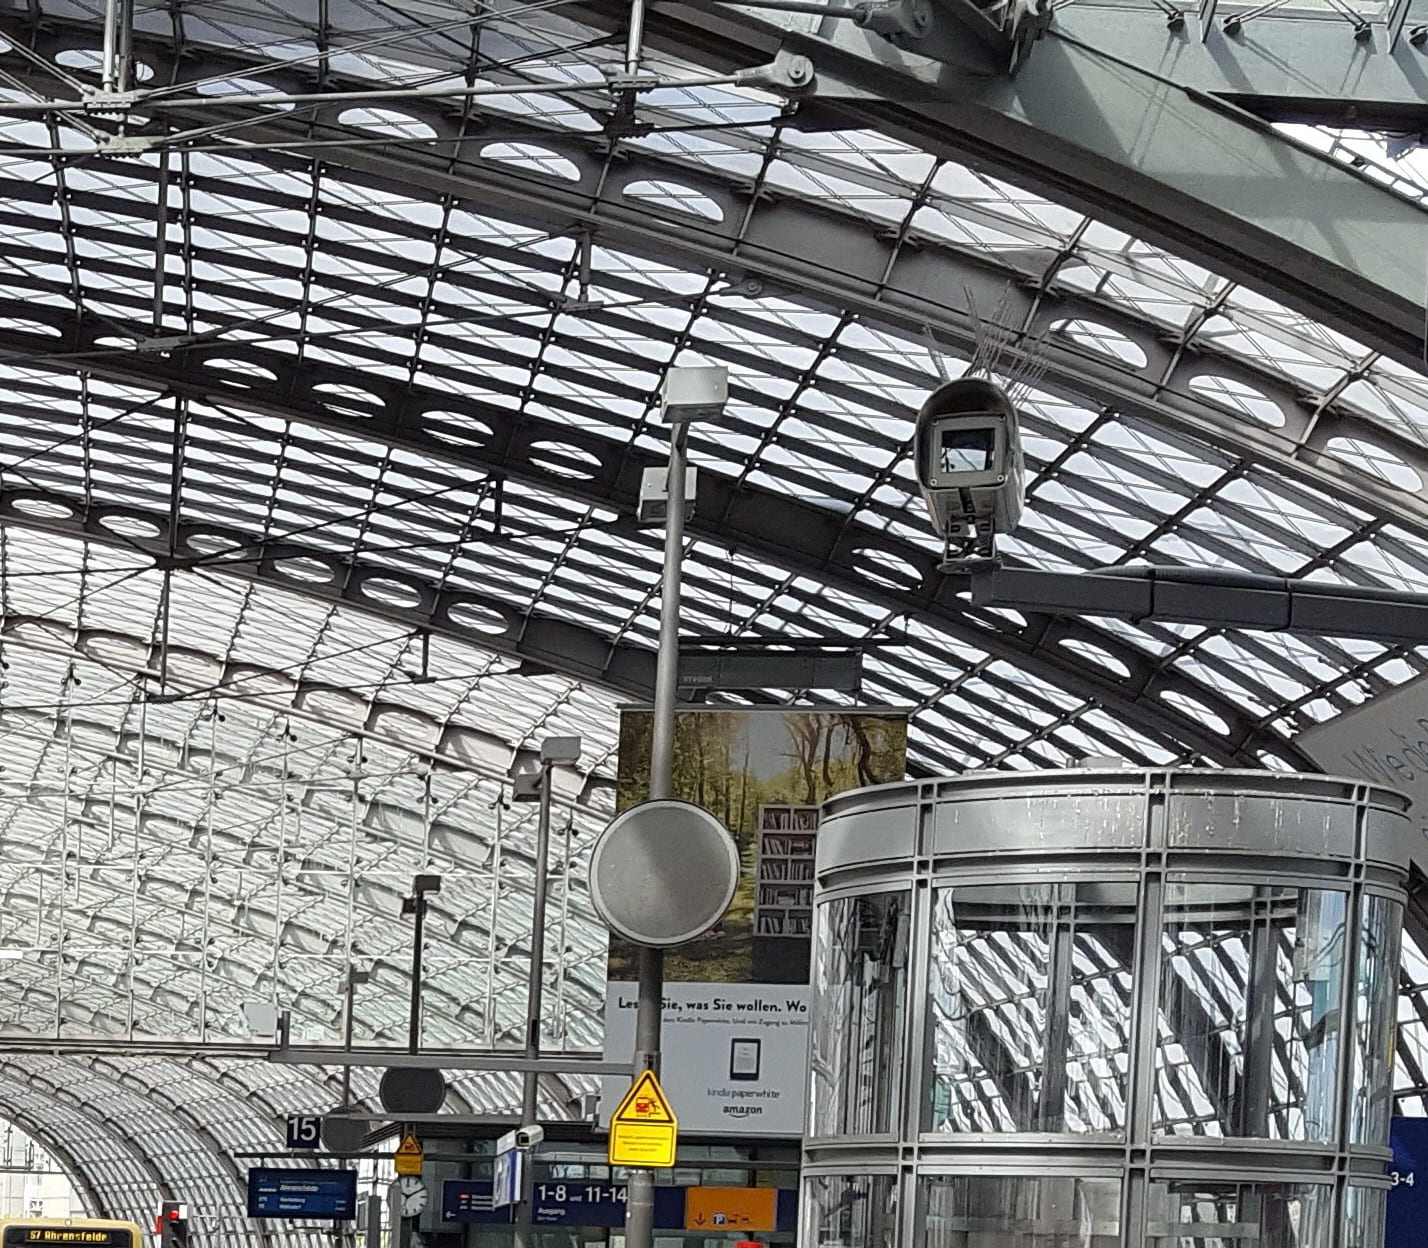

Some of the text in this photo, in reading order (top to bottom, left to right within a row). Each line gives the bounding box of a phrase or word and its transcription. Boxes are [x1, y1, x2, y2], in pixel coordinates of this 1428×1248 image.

[687, 1003, 709, 1011] was
[713, 999, 732, 1011] Sie
[737, 1000, 781, 1013] wollen.
[786, 1000, 806, 1013] Wo
[723, 1106, 762, 1116] amazon
[288, 1117, 316, 1141] 15
[538, 1184, 566, 1202] 1-8
[586, 1186, 627, 1203] 11-14
[44, 1231, 107, 1242] Ahrensfelde
